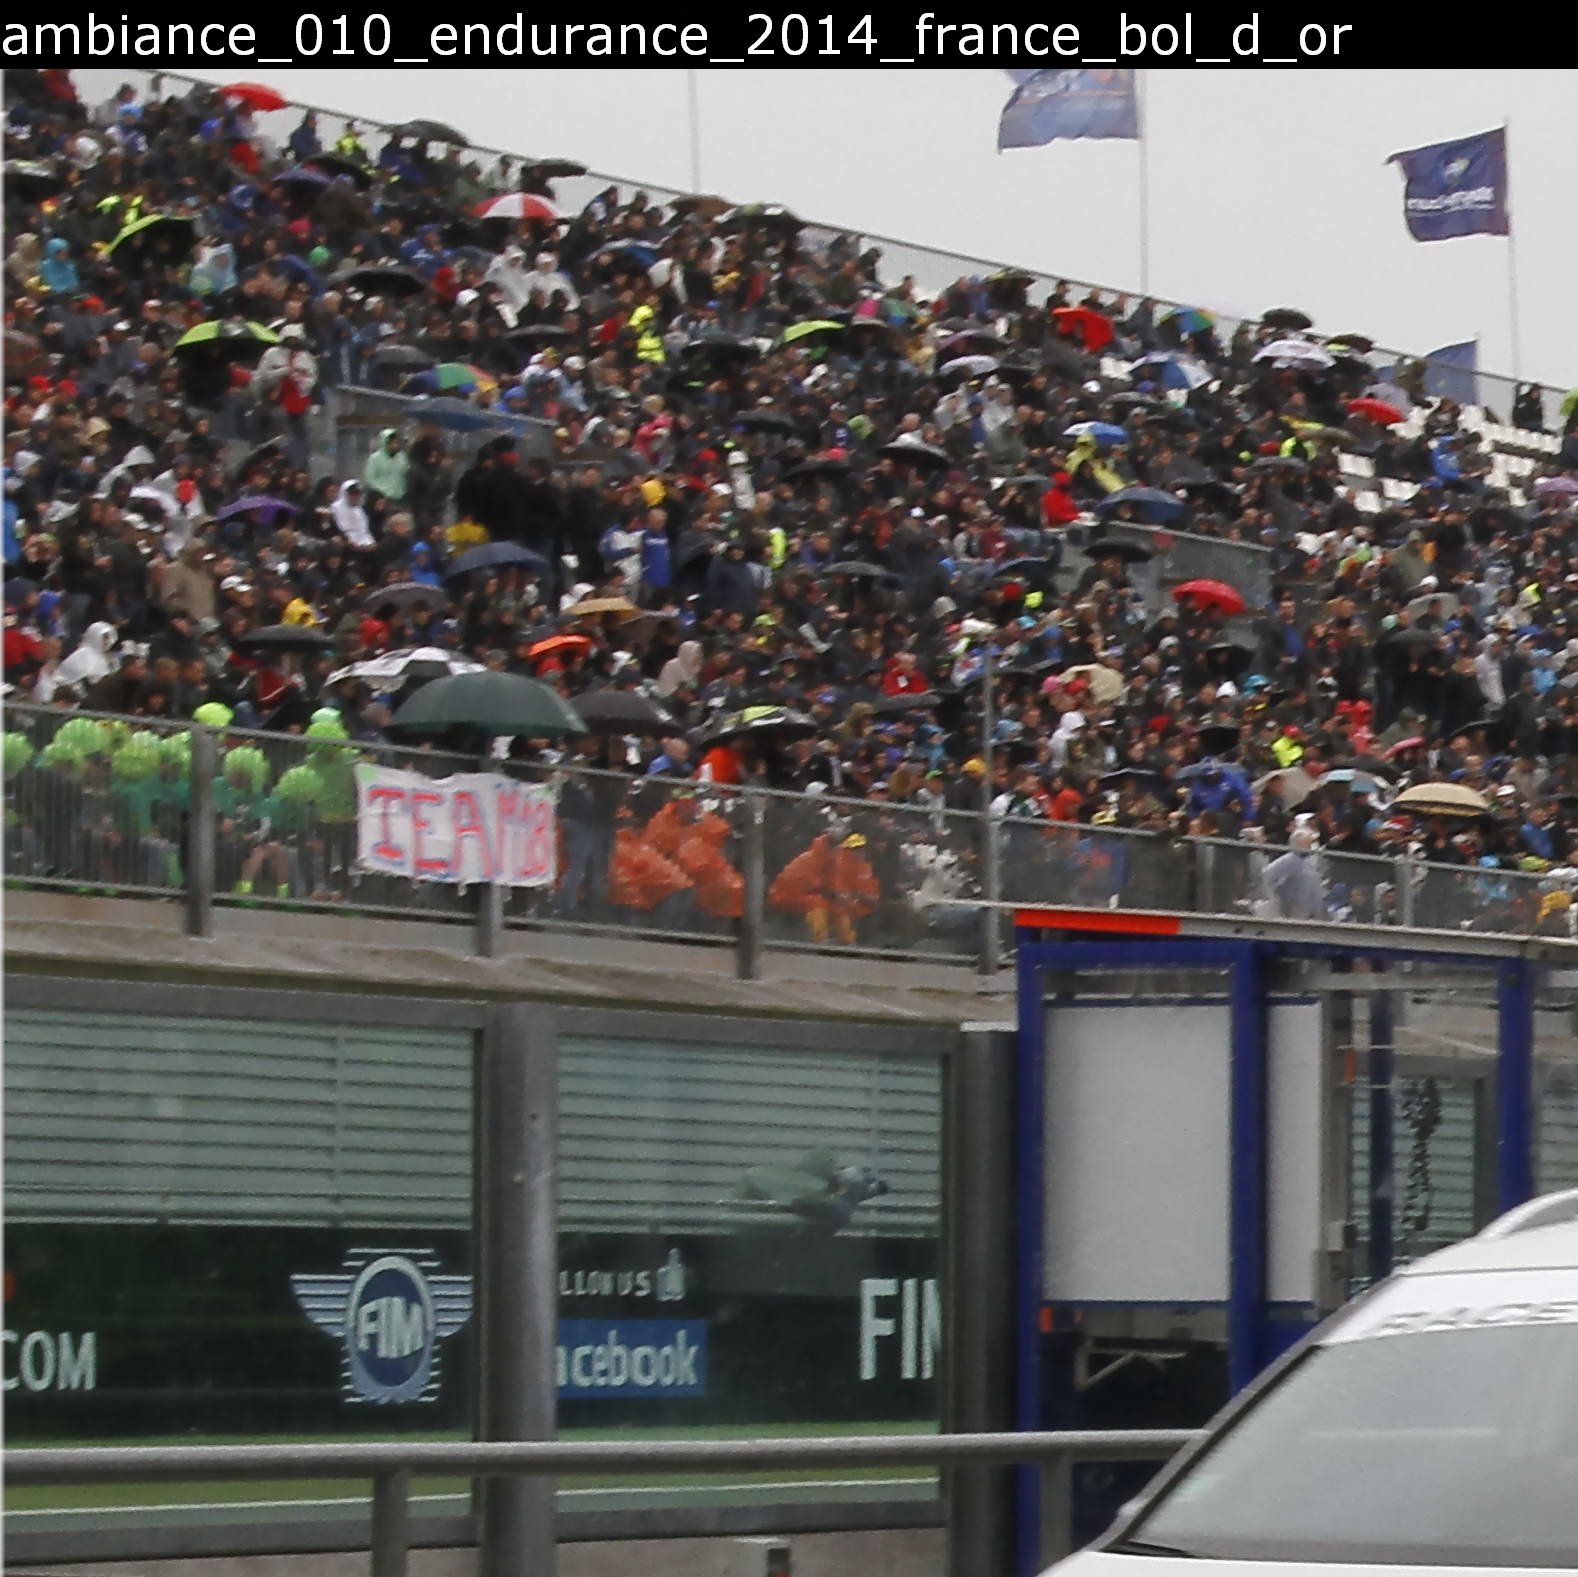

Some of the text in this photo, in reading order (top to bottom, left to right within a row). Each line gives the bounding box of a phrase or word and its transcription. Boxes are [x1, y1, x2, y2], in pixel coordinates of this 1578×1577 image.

[559, 1268, 614, 1298] LLOW
[358, 1296, 425, 1359] FIM
[556, 1328, 701, 1388] cebook
